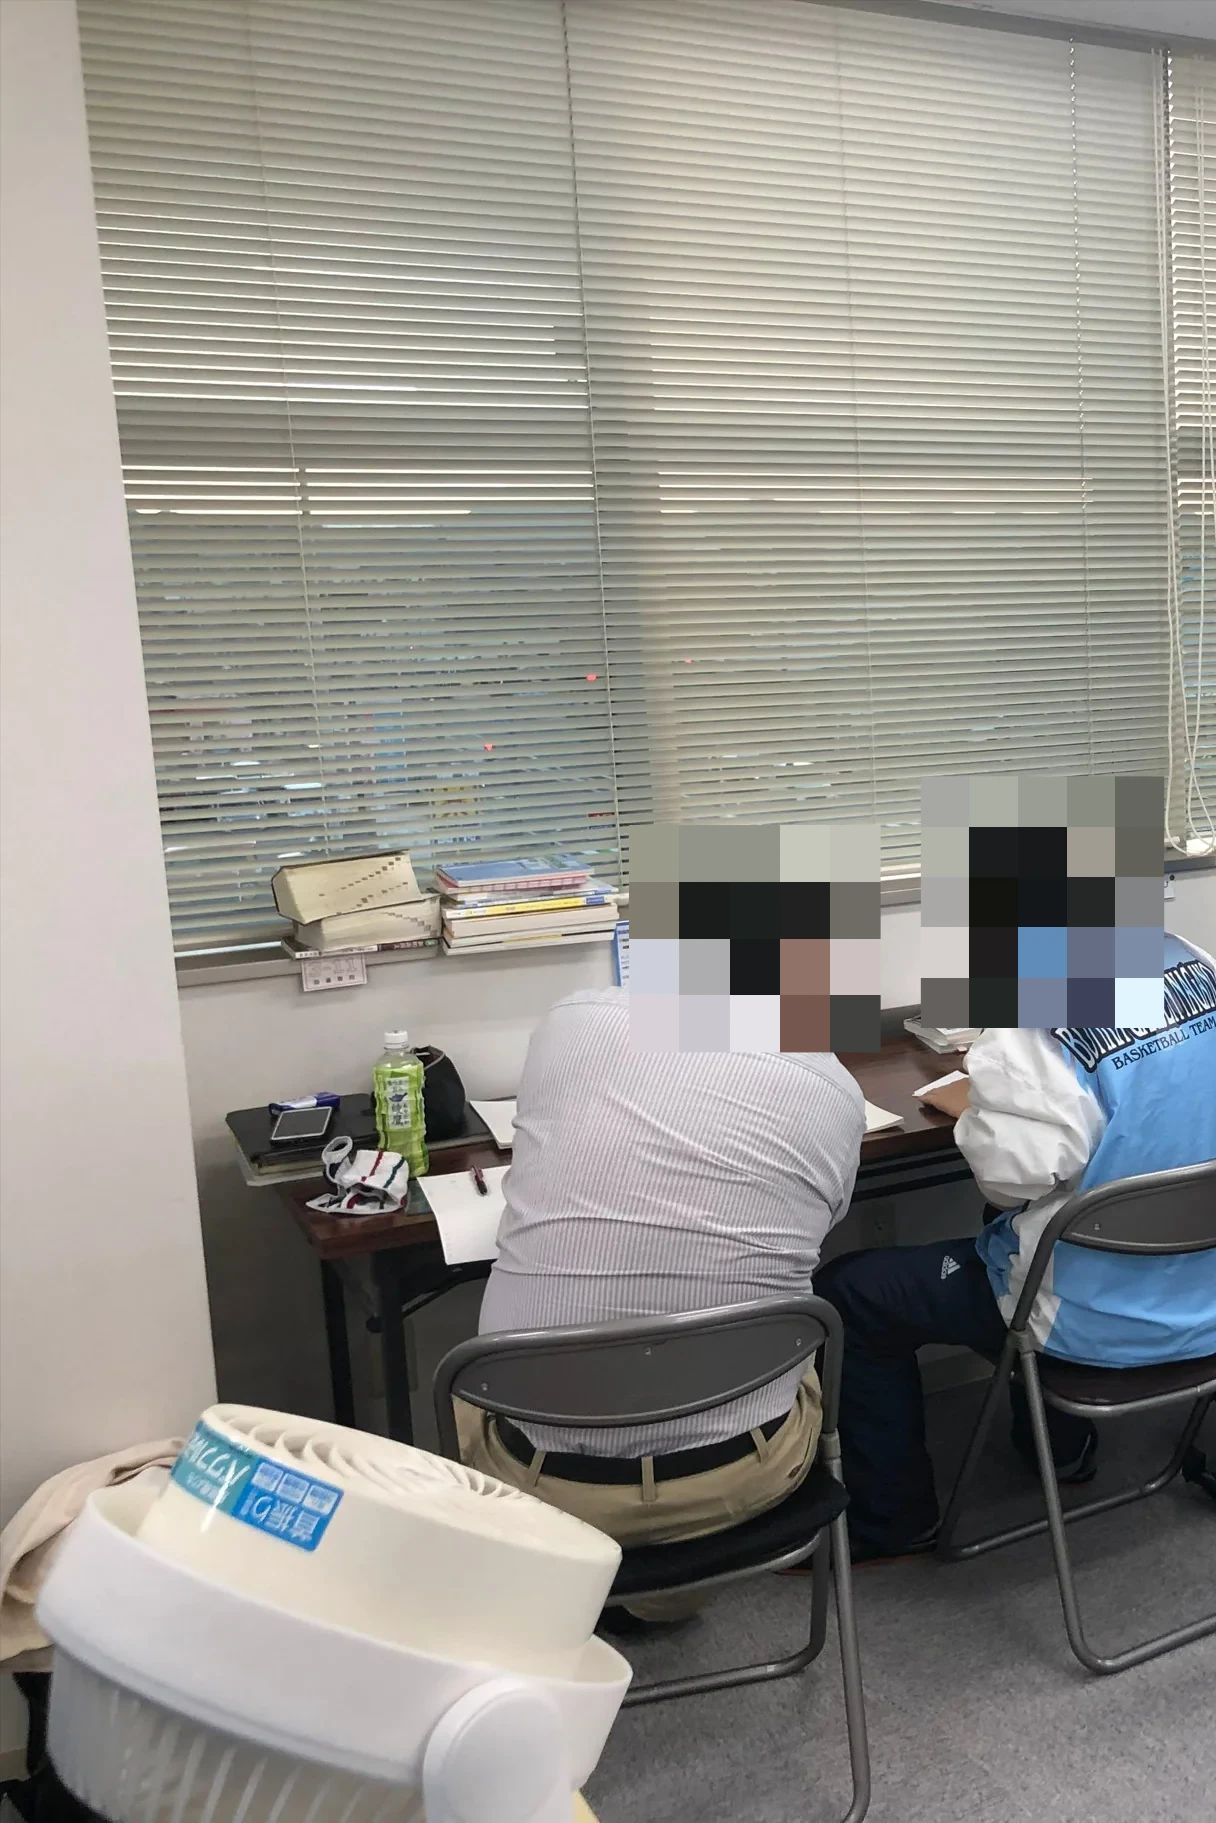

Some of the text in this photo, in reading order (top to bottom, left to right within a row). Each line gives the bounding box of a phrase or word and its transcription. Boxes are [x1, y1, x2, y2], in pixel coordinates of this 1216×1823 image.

[1111, 1029, 1190, 1070] BASKETBALL
[252, 1495, 320, 1541] 首振り
